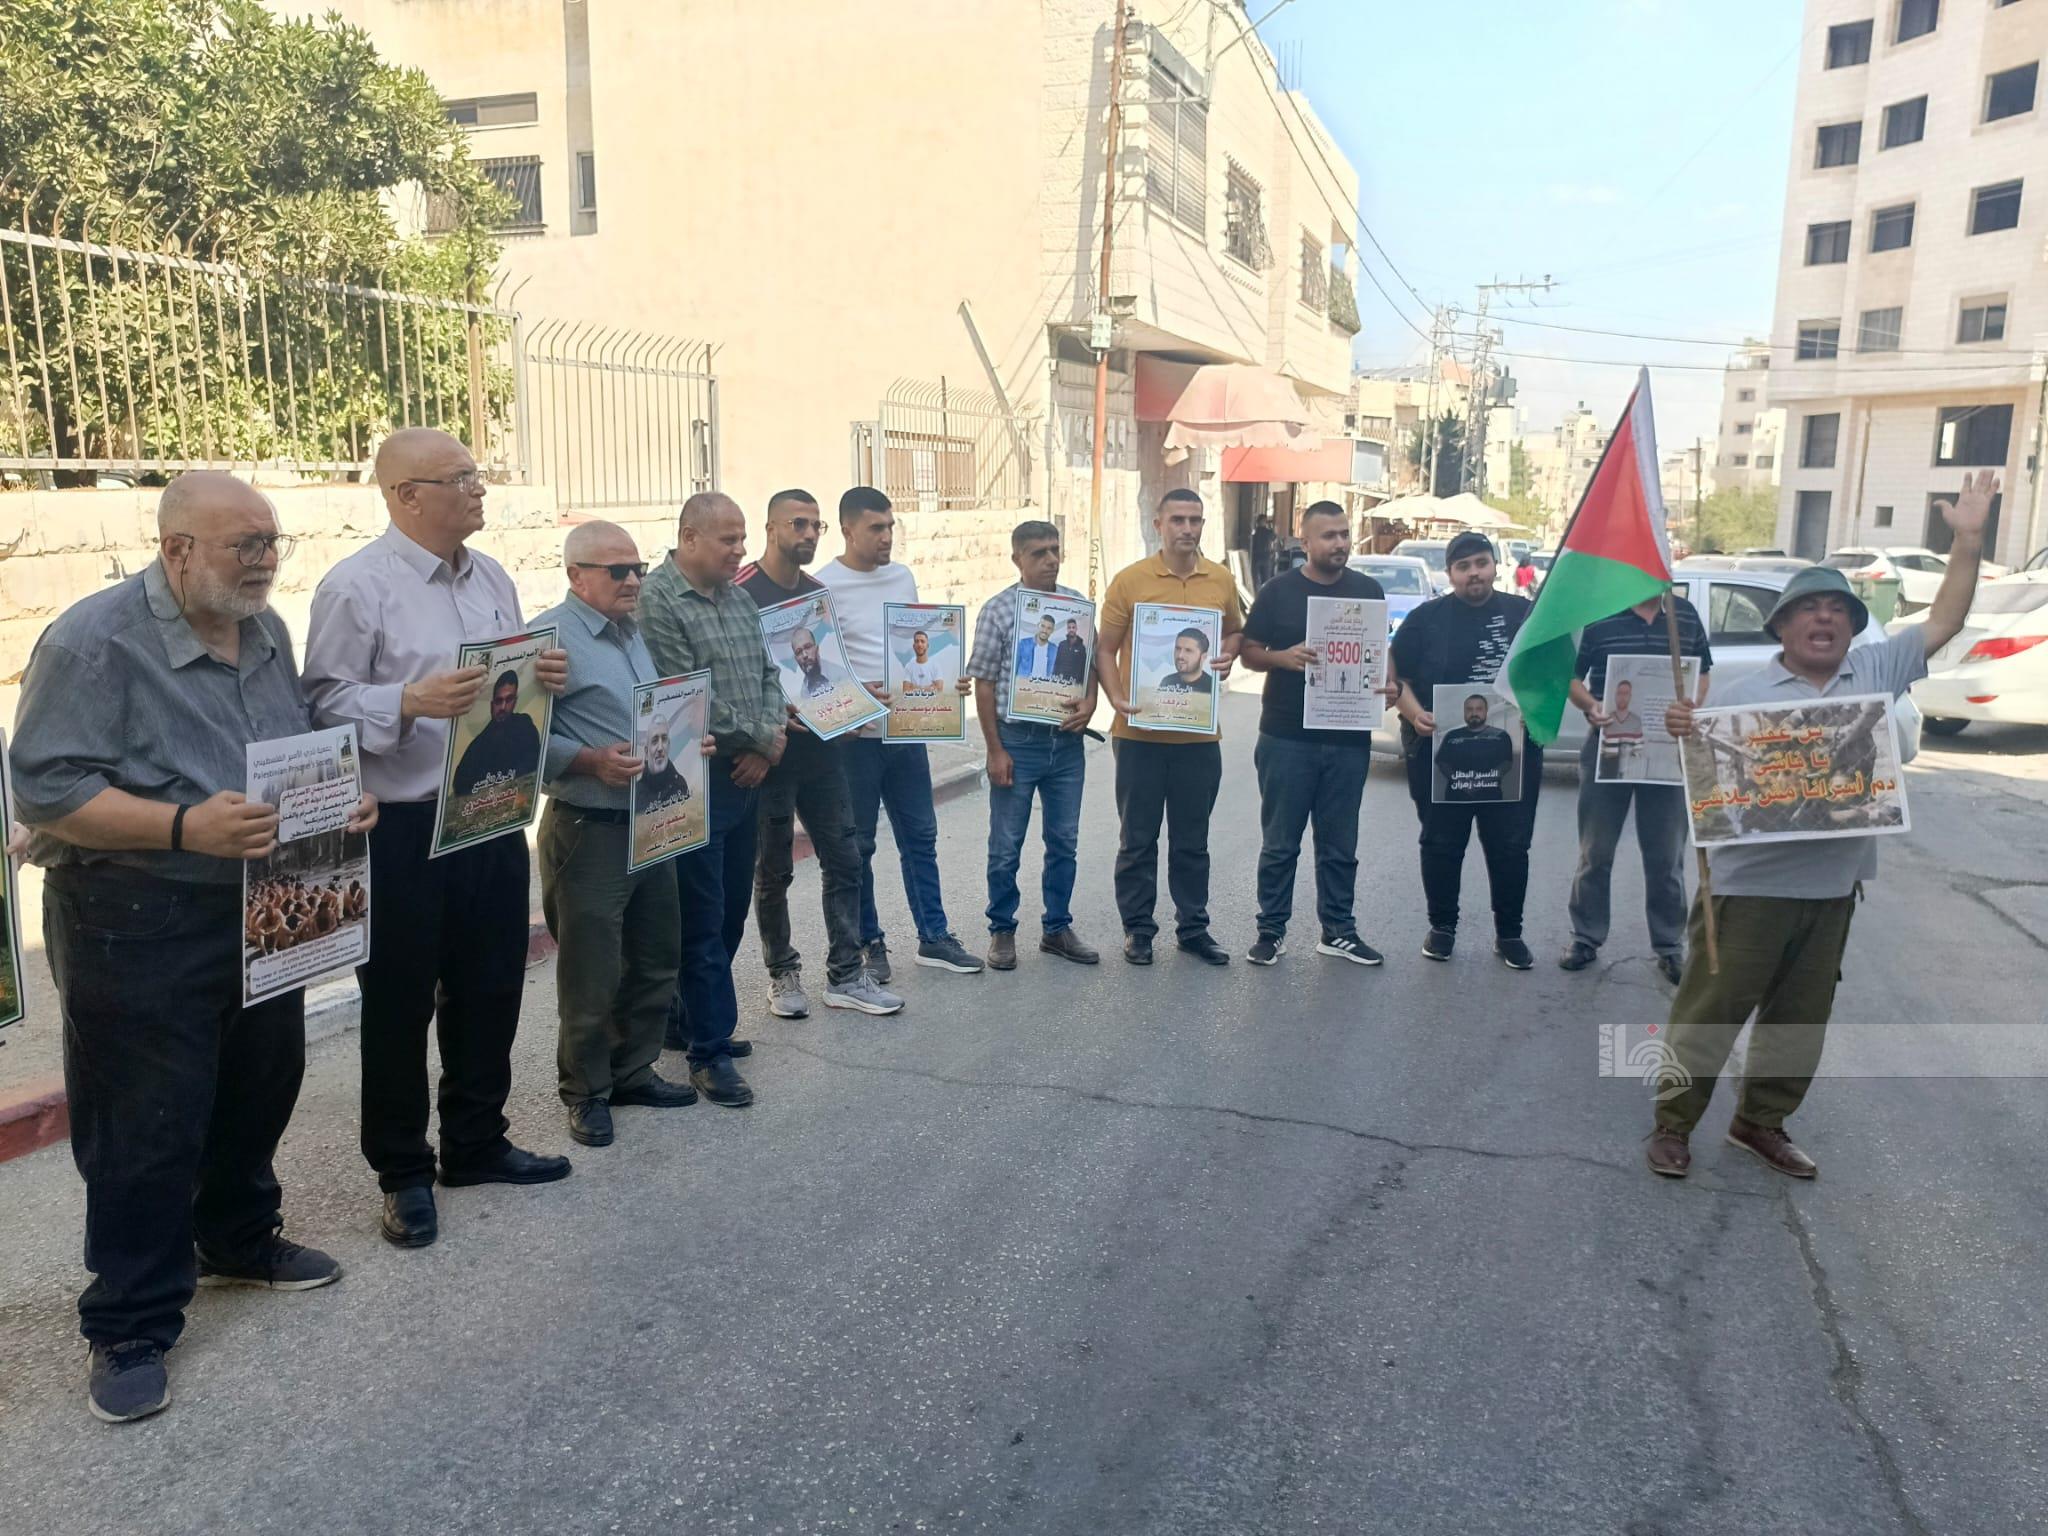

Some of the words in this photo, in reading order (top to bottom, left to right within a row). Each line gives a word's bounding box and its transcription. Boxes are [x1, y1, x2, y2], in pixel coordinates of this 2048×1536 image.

[1327, 640, 1361, 666] 9500
[1798, 725, 1824, 745] بن
[253, 753, 285, 768] الفلسطيني
[1753, 750, 1806, 785] فاشي
[1810, 752, 1831, 773] يا
[253, 766, 288, 780] Palestinian
[1450, 769, 1475, 781] البطل
[1475, 768, 1499, 780] الأسير
[1450, 780, 1473, 791] زهران
[1473, 780, 1499, 789] عساف
[1871, 777, 1896, 797] دم
[1758, 782, 1796, 808] مش
